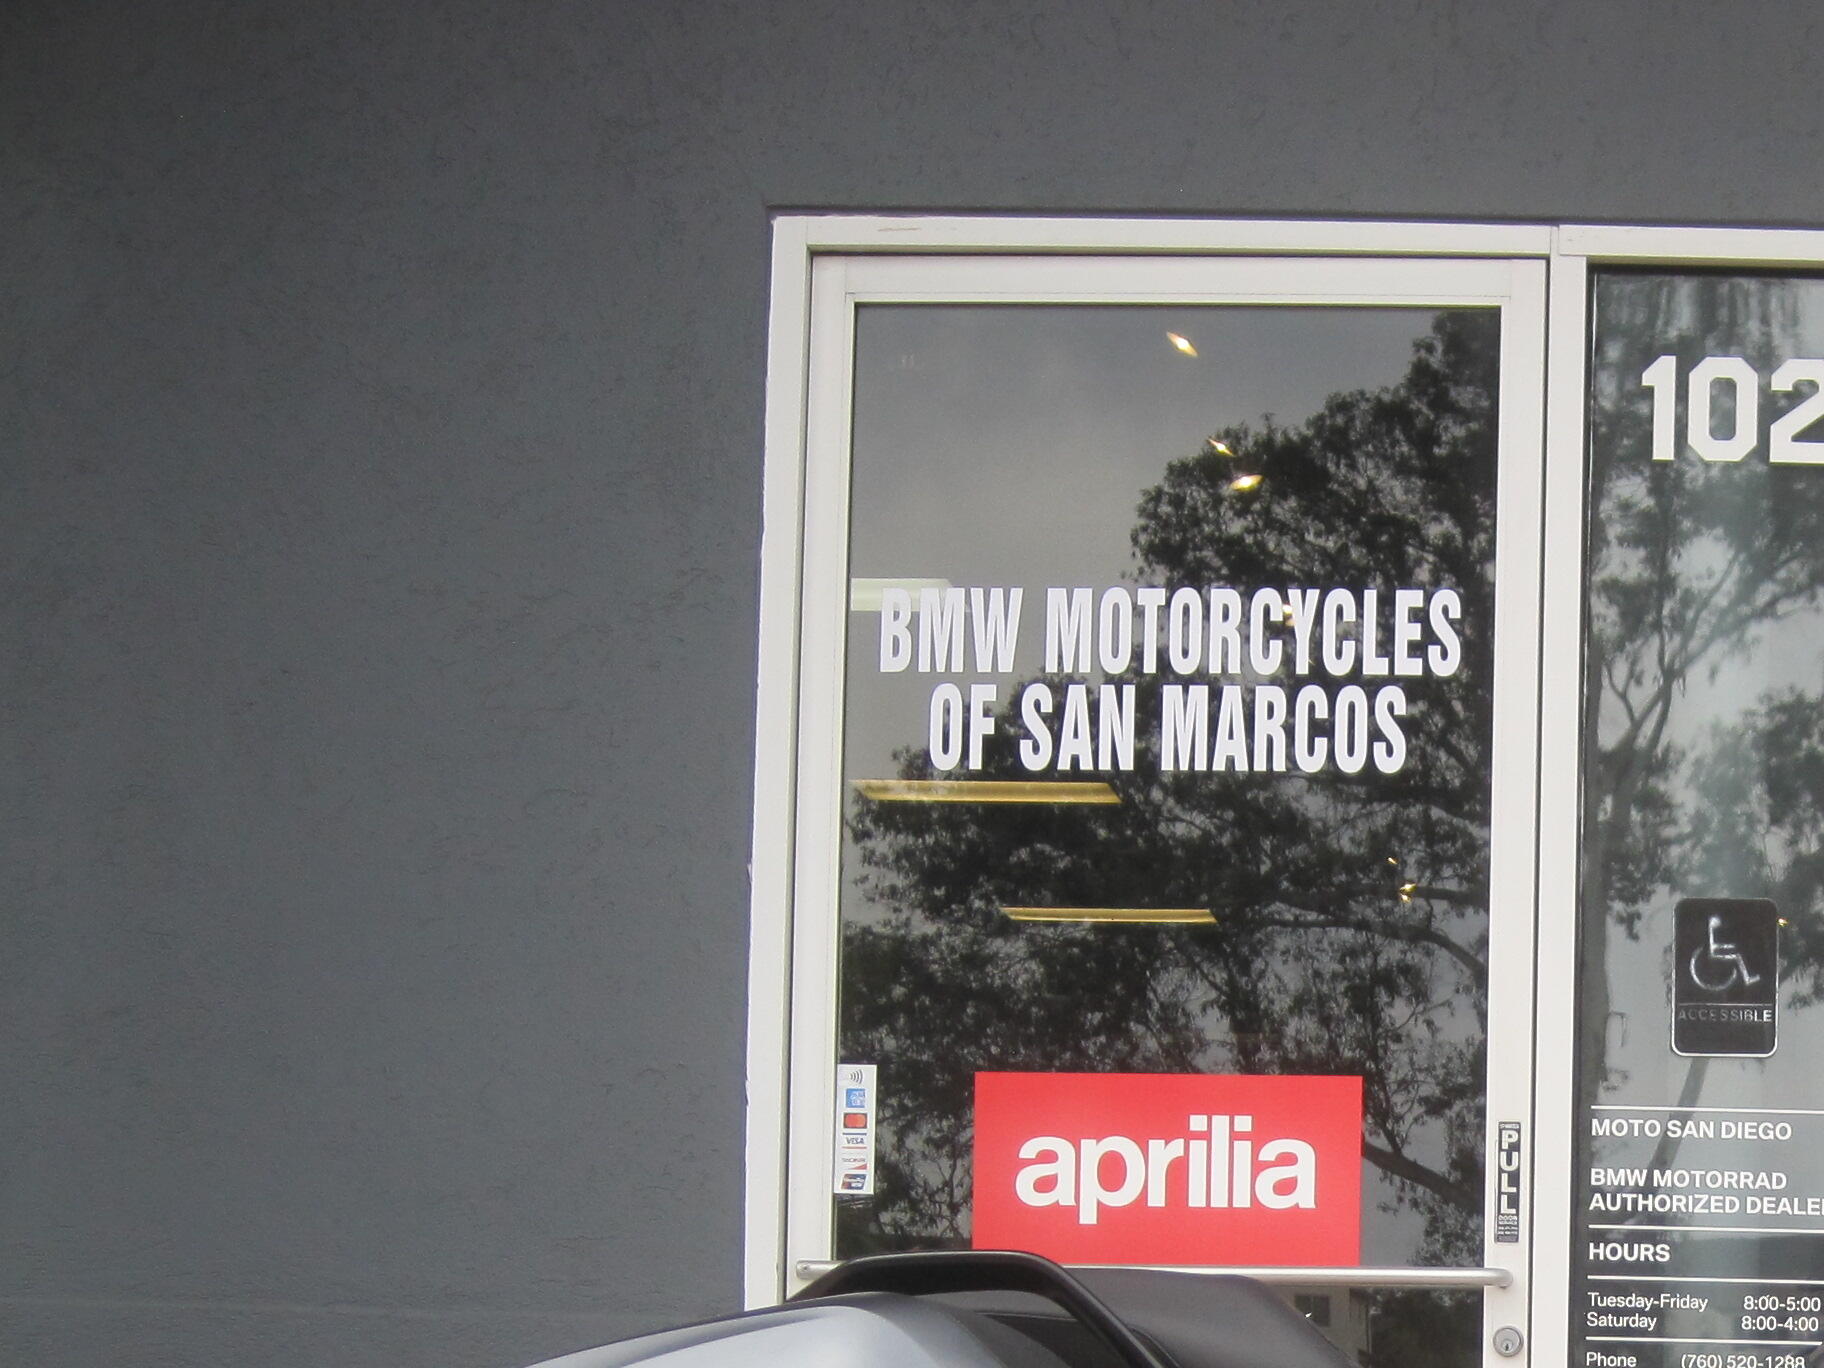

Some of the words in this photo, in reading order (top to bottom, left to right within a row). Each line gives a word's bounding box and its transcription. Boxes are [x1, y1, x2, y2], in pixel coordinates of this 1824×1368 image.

[878, 586, 1024, 674] BMW
[1045, 586, 1462, 677] MOTORCYCLES
[928, 682, 998, 772] OF
[1019, 683, 1136, 772] SAN
[1160, 684, 1408, 774] MARCOS
[1677, 1009, 1773, 1022] ACCESSIBLE
[1591, 1118, 1661, 1137] MOTO
[1666, 1119, 1714, 1139] SAN
[1721, 1121, 1792, 1140] DIEGO
[1014, 1114, 1317, 1225] aprilia
[1499, 1129, 1519, 1215] PULL
[1590, 1168, 1647, 1187] BMW
[1653, 1169, 1788, 1190] MOTORRAD
[1589, 1193, 1740, 1214] AUTHORIZED
[1589, 1243, 1671, 1262] HOURS
[1587, 1292, 1708, 1313] Tuesday-Friday
[1743, 1296, 1821, 1312] 8:00-5:00
[1586, 1312, 1657, 1331] Saturday
[1741, 1316, 1819, 1332] 8:00-4:00
[1586, 1352, 1637, 1368] Phone
